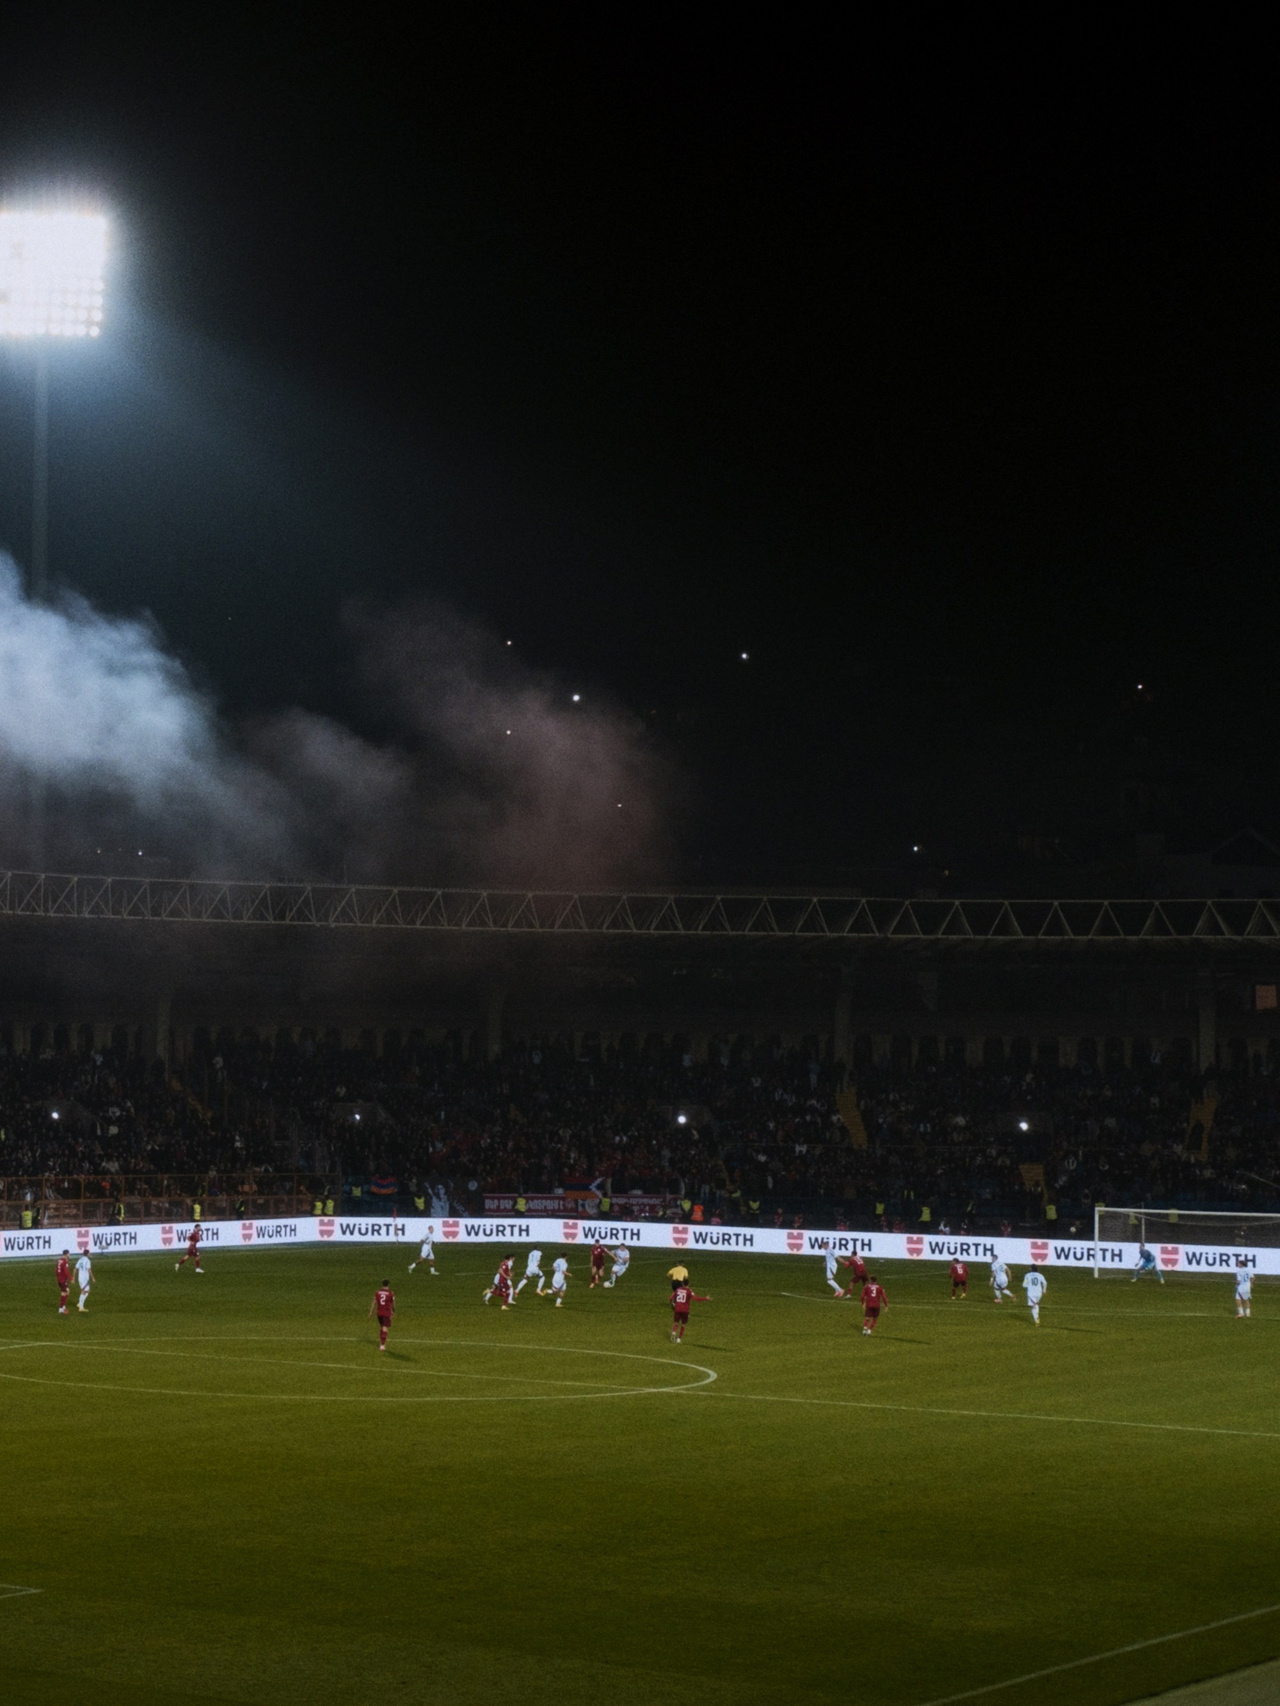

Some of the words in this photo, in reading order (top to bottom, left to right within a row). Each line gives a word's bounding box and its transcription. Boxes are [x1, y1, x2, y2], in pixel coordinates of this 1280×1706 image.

[176, 1228, 219, 1242] WRTH
[255, 1223, 298, 1239] WÜRTH
[339, 1223, 406, 1237] WÜRTH
[464, 1224, 530, 1238] WÜRTH
[582, 1226, 641, 1242] WÜRTH
[3, 1235, 53, 1251] WÜRTH
[91, 1231, 139, 1247] WÜRTH
[692, 1231, 754, 1248] WÜRTH
[928, 1241, 995, 1257] WÜRTH
[1053, 1246, 1123, 1262] WÜRTH
[1185, 1251, 1257, 1269] WÜRTH
[1030, 1277, 1039, 1286] 10
[379, 1294, 386, 1305] 2
[676, 1291, 687, 1303] 20
[870, 1288, 877, 1297] 3
